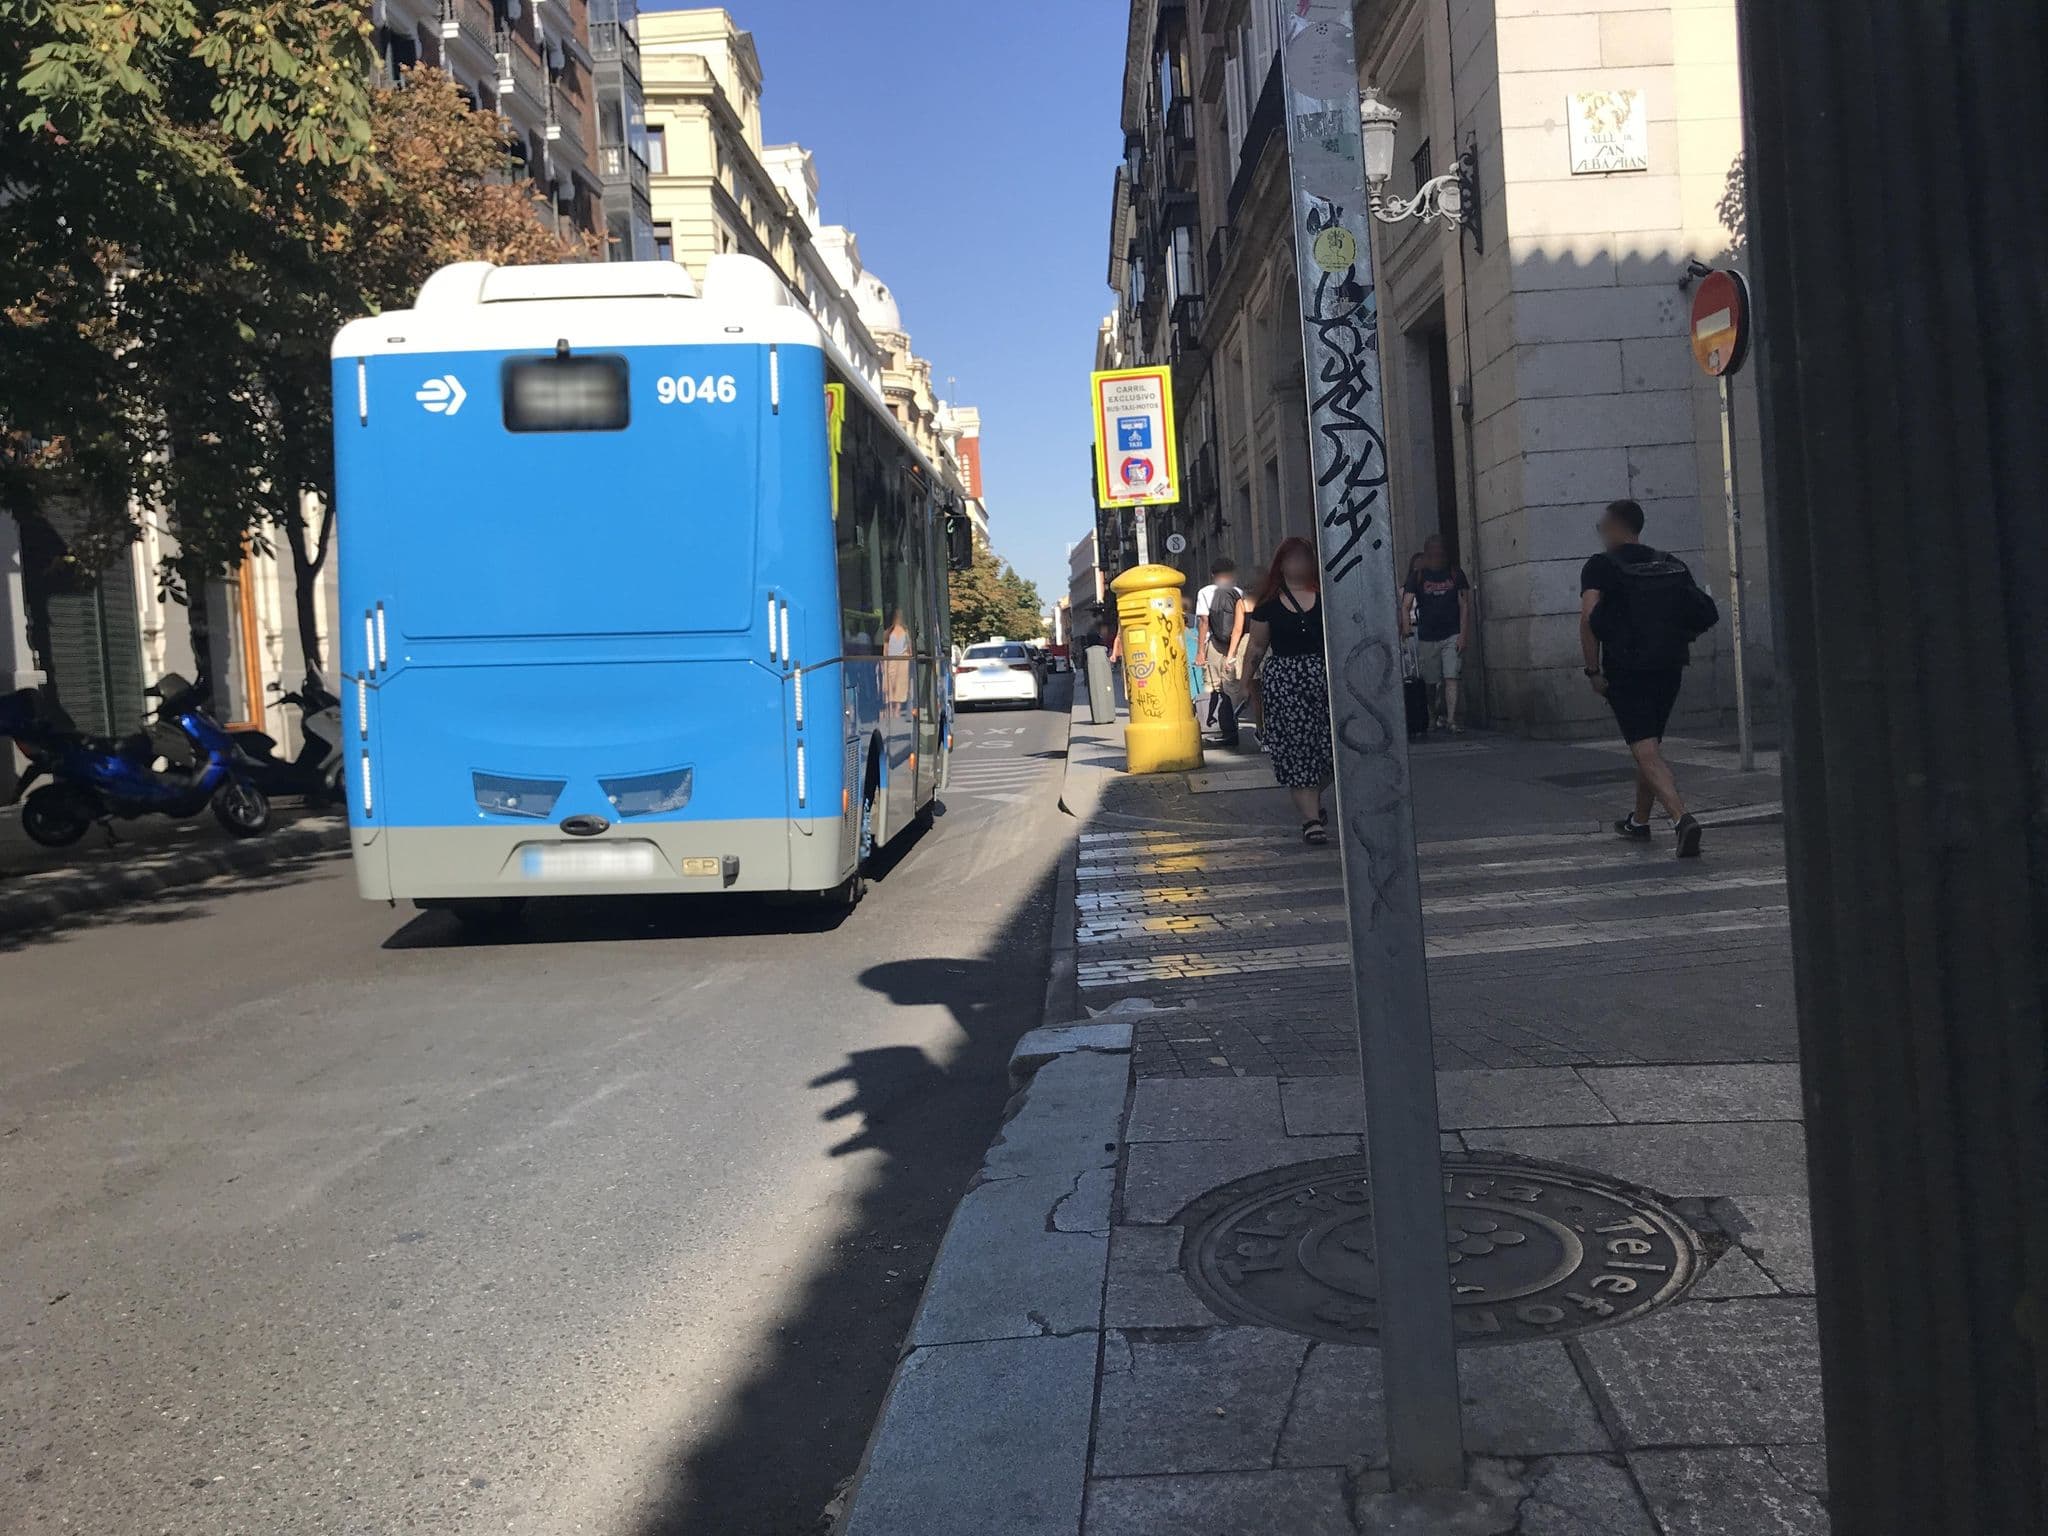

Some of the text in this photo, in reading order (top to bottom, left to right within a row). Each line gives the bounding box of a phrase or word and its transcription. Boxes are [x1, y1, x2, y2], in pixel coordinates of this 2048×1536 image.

[656, 374, 737, 404] 9046
[1115, 384, 1147, 394] CARRIL
[1108, 393, 1156, 403] EXCLUSIVO
